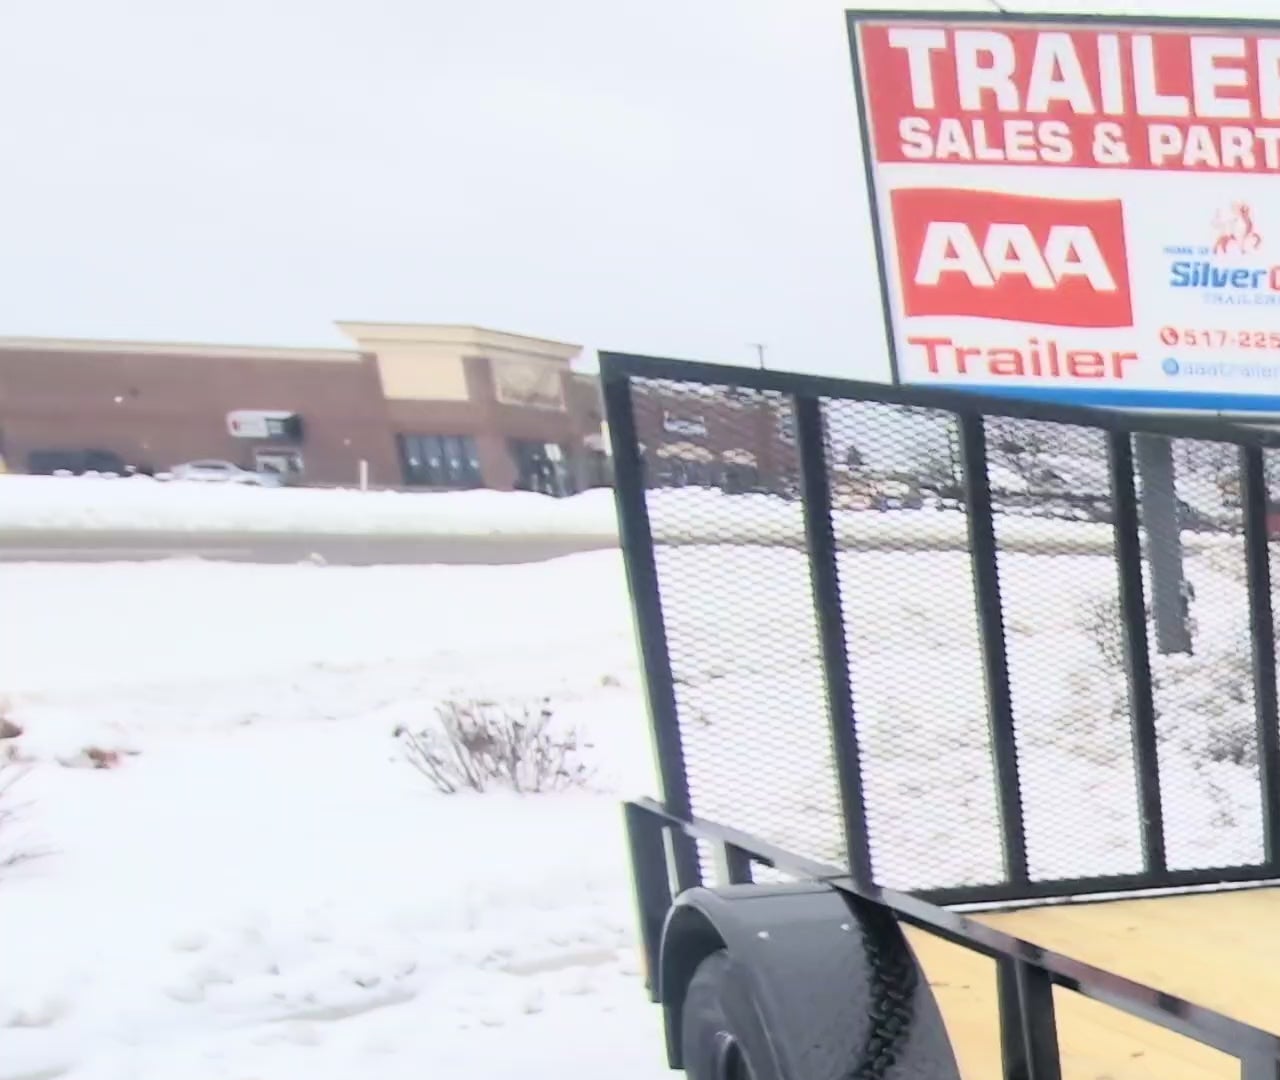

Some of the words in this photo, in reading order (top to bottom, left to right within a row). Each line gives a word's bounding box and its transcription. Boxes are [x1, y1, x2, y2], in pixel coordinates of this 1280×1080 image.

[900, 117, 1073, 163] SALES
[1092, 123, 1131, 164] &
[914, 221, 1118, 291] AAA
[907, 337, 1139, 380] Trailer
